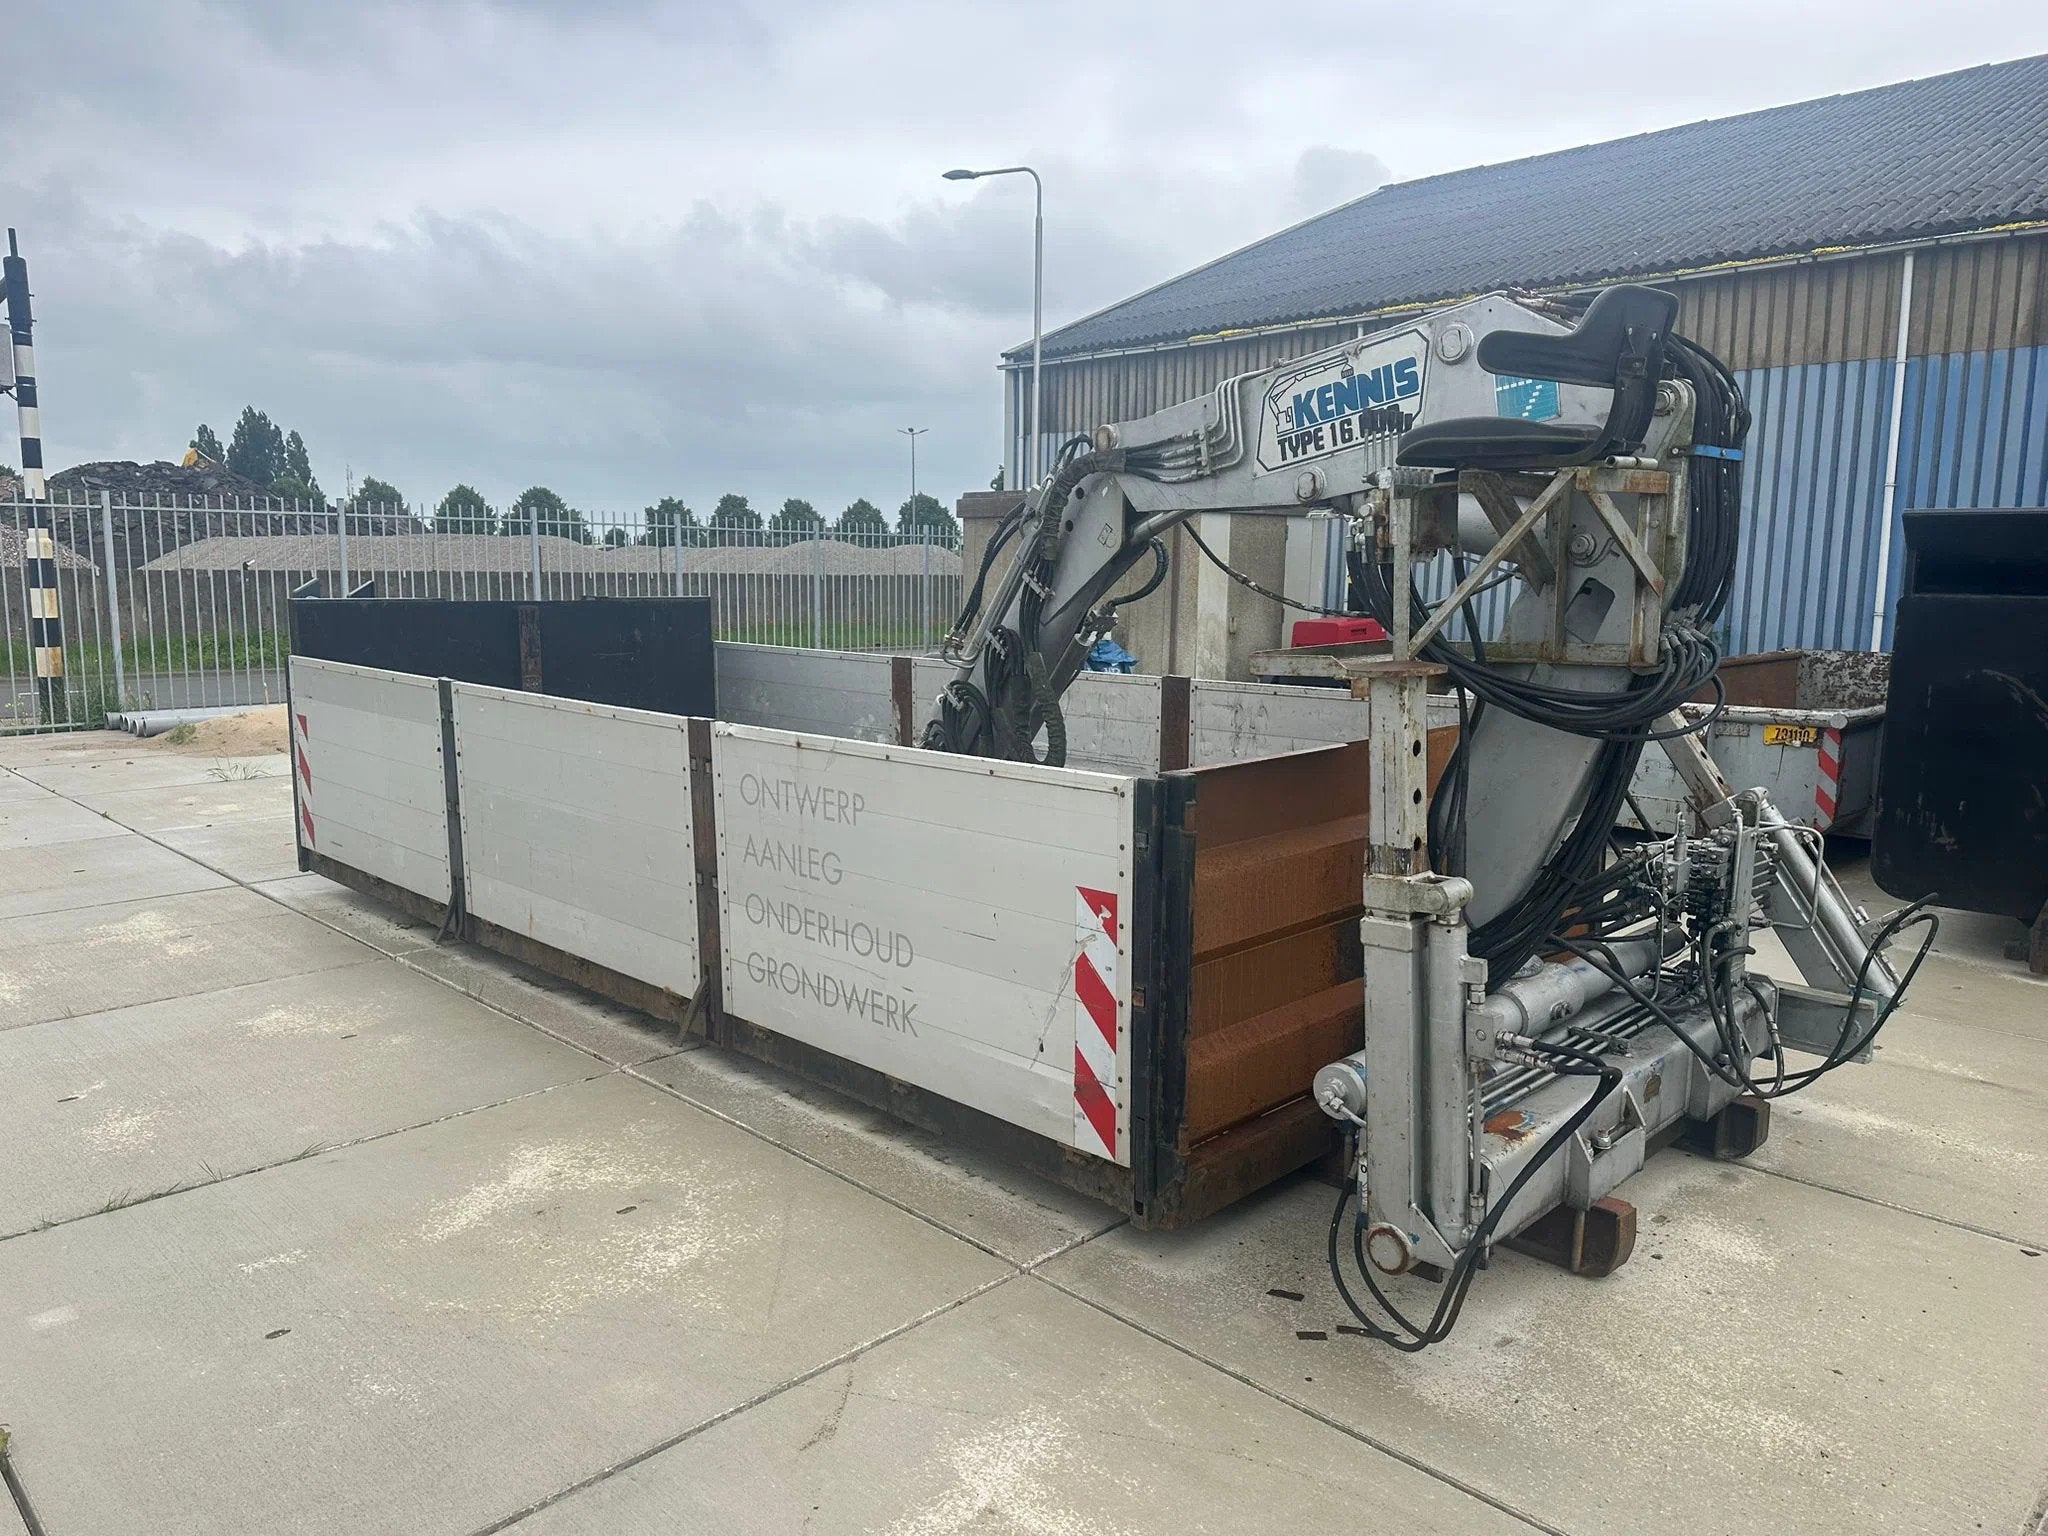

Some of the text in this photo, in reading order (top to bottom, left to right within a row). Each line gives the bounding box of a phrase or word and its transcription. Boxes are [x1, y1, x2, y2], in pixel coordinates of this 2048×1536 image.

[1292, 356, 1420, 429] KENNIS
[1277, 427, 1326, 462] TYPE
[740, 773, 865, 826] ONTWERP
[743, 834, 843, 885] AANLEG
[745, 893, 914, 969] ONDERHOUD
[747, 952, 919, 1038] GRONDWERK
